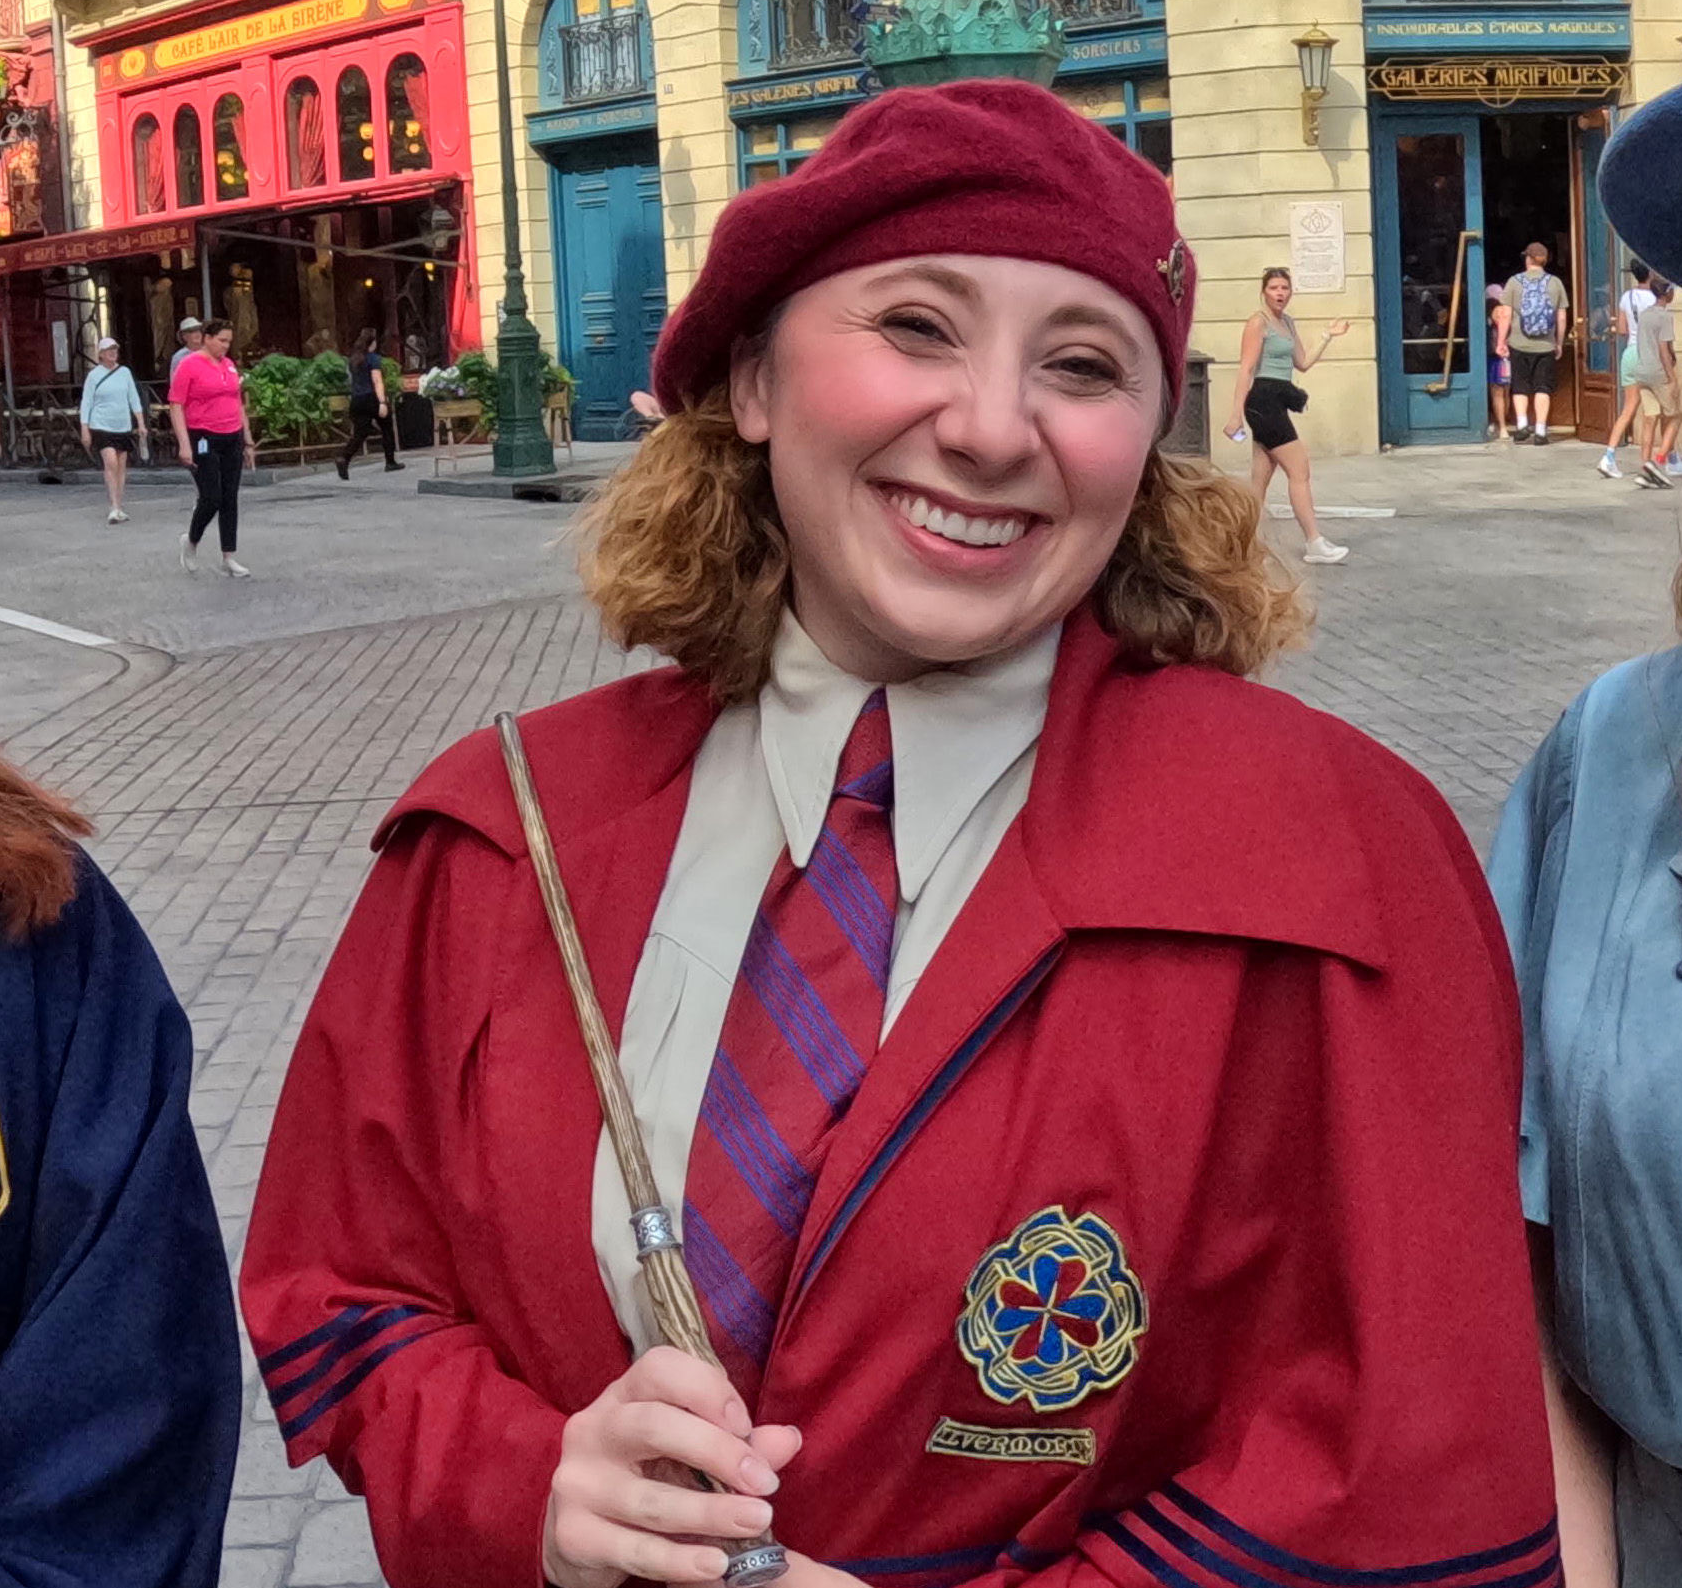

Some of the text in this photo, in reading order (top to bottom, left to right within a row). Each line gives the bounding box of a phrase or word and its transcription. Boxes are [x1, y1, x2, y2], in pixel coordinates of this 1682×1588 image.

[171, 35, 205, 60] CAFÉ
[208, 27, 240, 50] L'AIR
[246, 20, 264, 41] DE
[269, 14, 287, 34] LA
[1376, 20, 1617, 35] INNOMBRABLES ÉTAGES MAGIQUES
[1071, 39, 1142, 61] SORCIERS
[1380, 66, 1612, 88] GALERIES MIRIFIQUES
